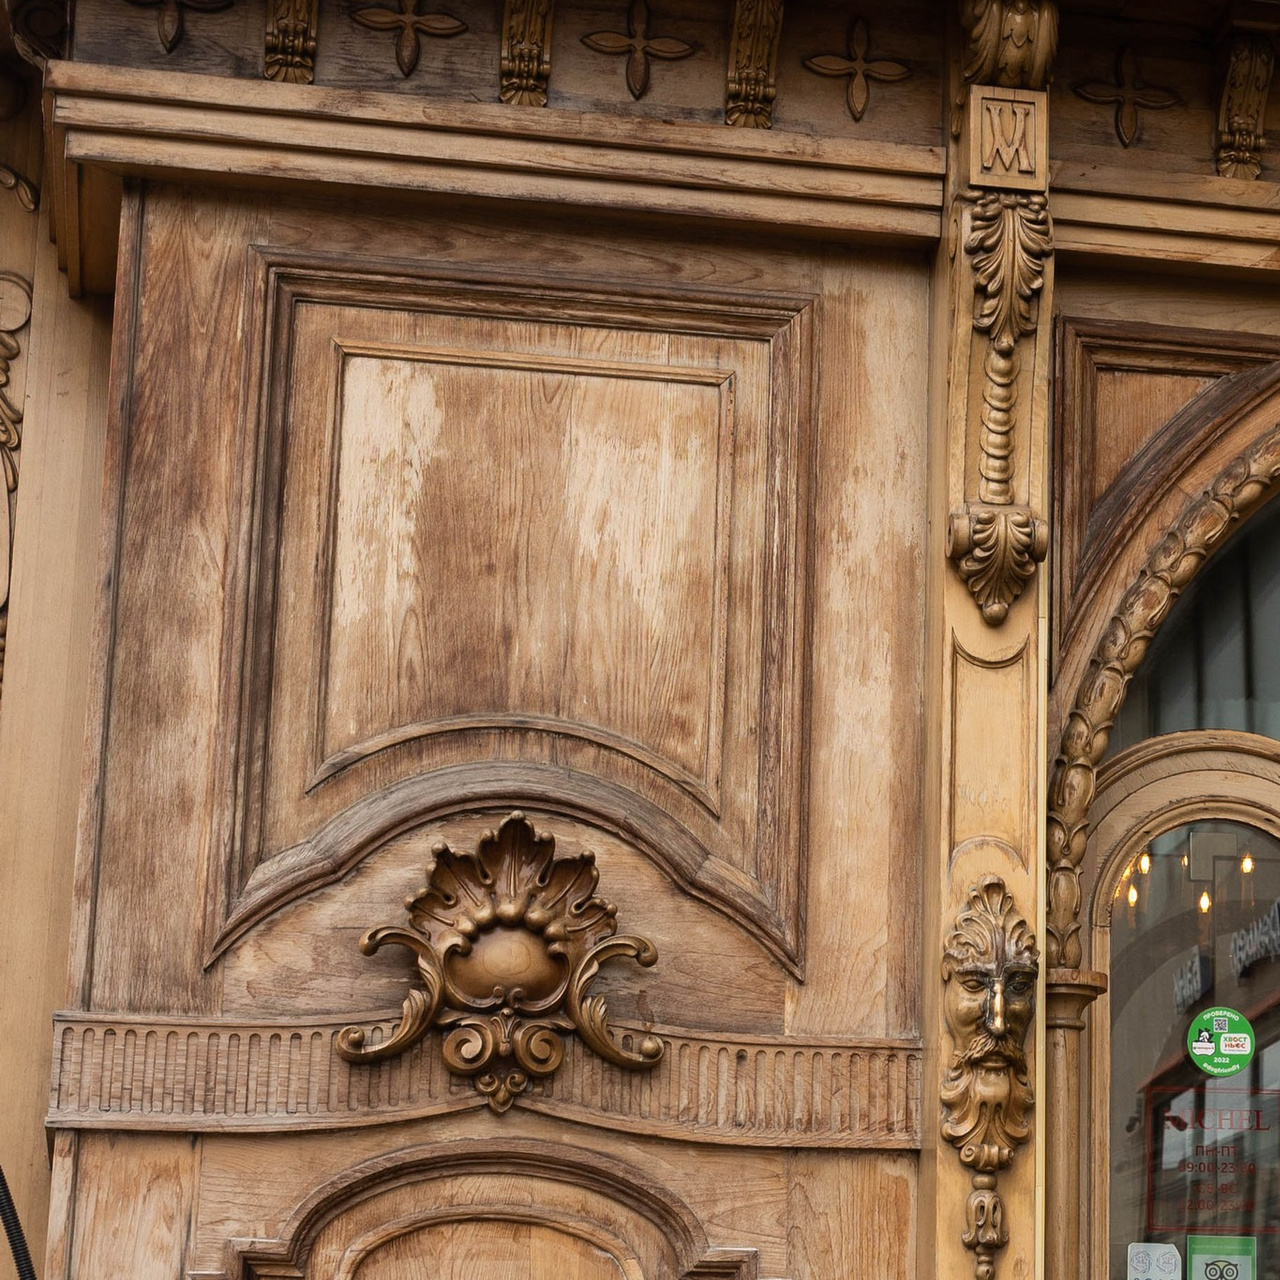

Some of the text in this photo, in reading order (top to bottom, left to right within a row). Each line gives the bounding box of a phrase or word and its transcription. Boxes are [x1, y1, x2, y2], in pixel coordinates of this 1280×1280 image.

[983, 104, 1035, 172] M
[1202, 1010, 1240, 1021] ПРОВЕРЕНО
[1163, 1109, 1271, 1131] MICHEL
